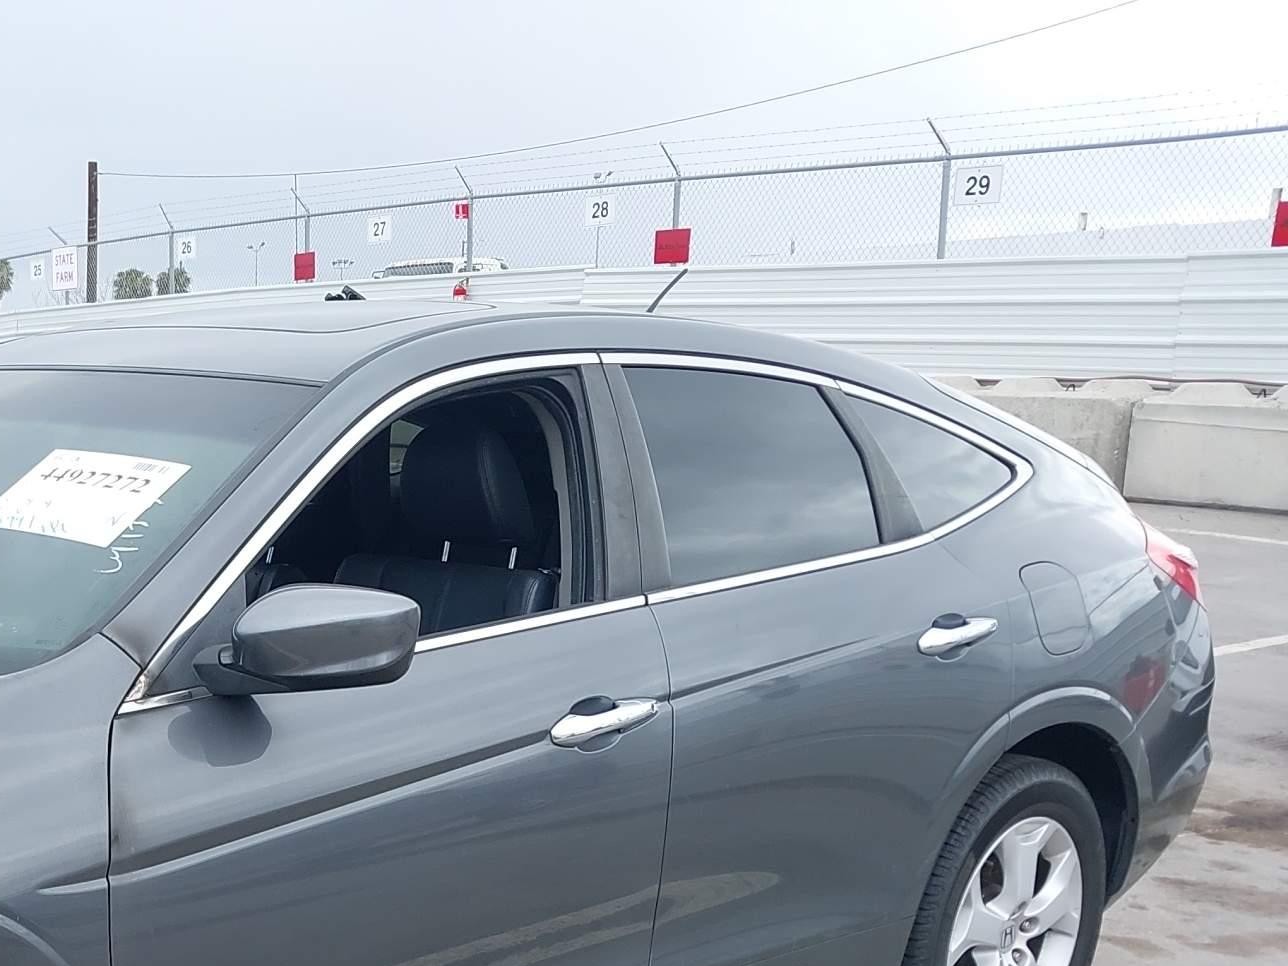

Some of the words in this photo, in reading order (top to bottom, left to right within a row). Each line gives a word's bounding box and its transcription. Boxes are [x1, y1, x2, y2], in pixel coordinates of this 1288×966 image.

[965, 175, 990, 196] 29
[591, 201, 610, 219] 28
[372, 221, 387, 237] 27
[181, 241, 192, 254] 26
[55, 253, 74, 266] STATE
[33, 264, 43, 277] 25
[55, 270, 74, 284] FARM
[39, 466, 152, 494] 44927272
